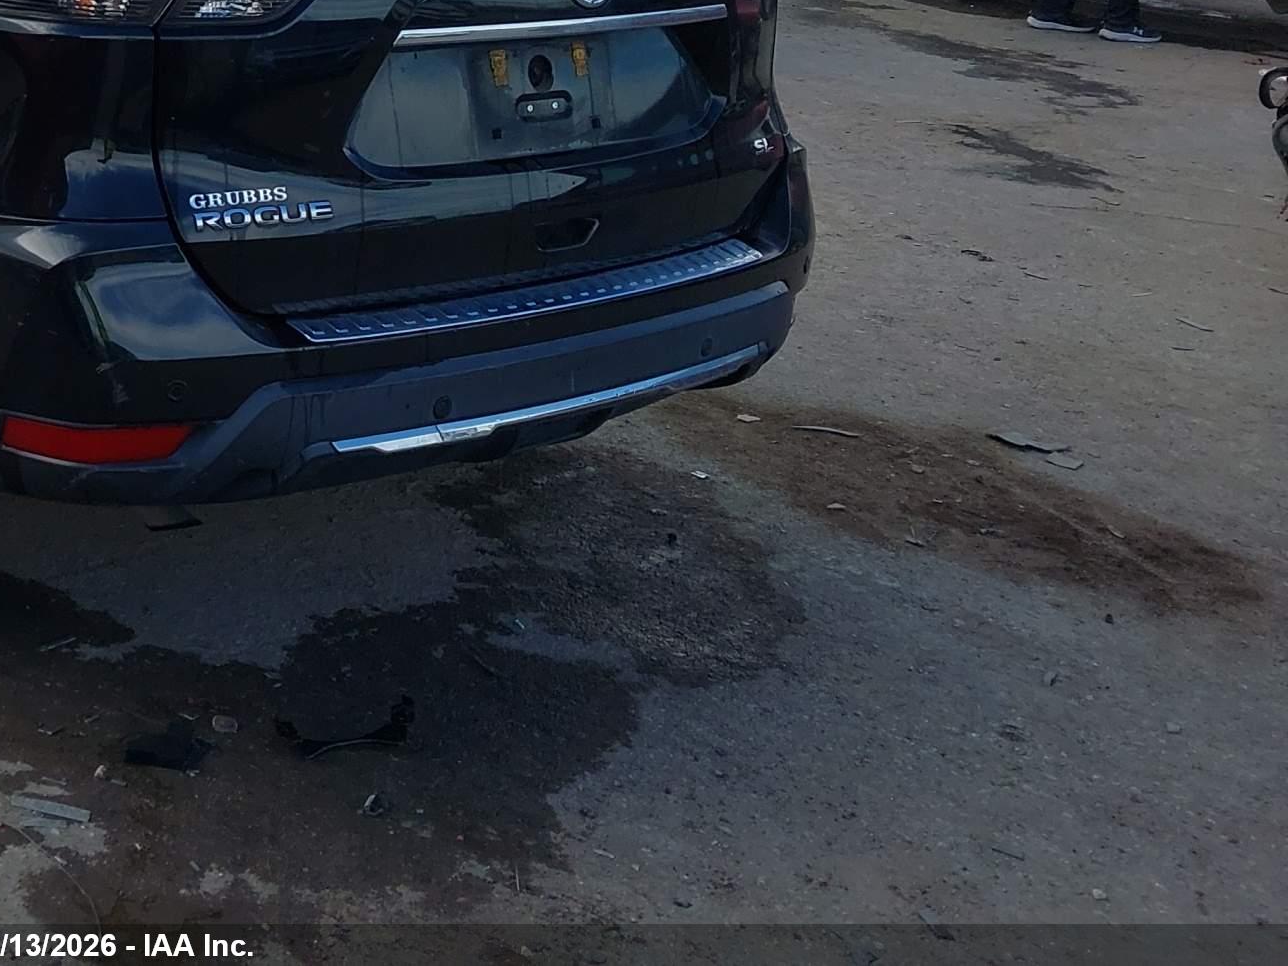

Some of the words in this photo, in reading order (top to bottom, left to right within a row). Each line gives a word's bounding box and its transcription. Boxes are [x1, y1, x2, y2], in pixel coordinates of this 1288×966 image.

[753, 137, 774, 152] SL
[189, 186, 288, 210] GRUBBS
[193, 201, 335, 232] ROGUE
